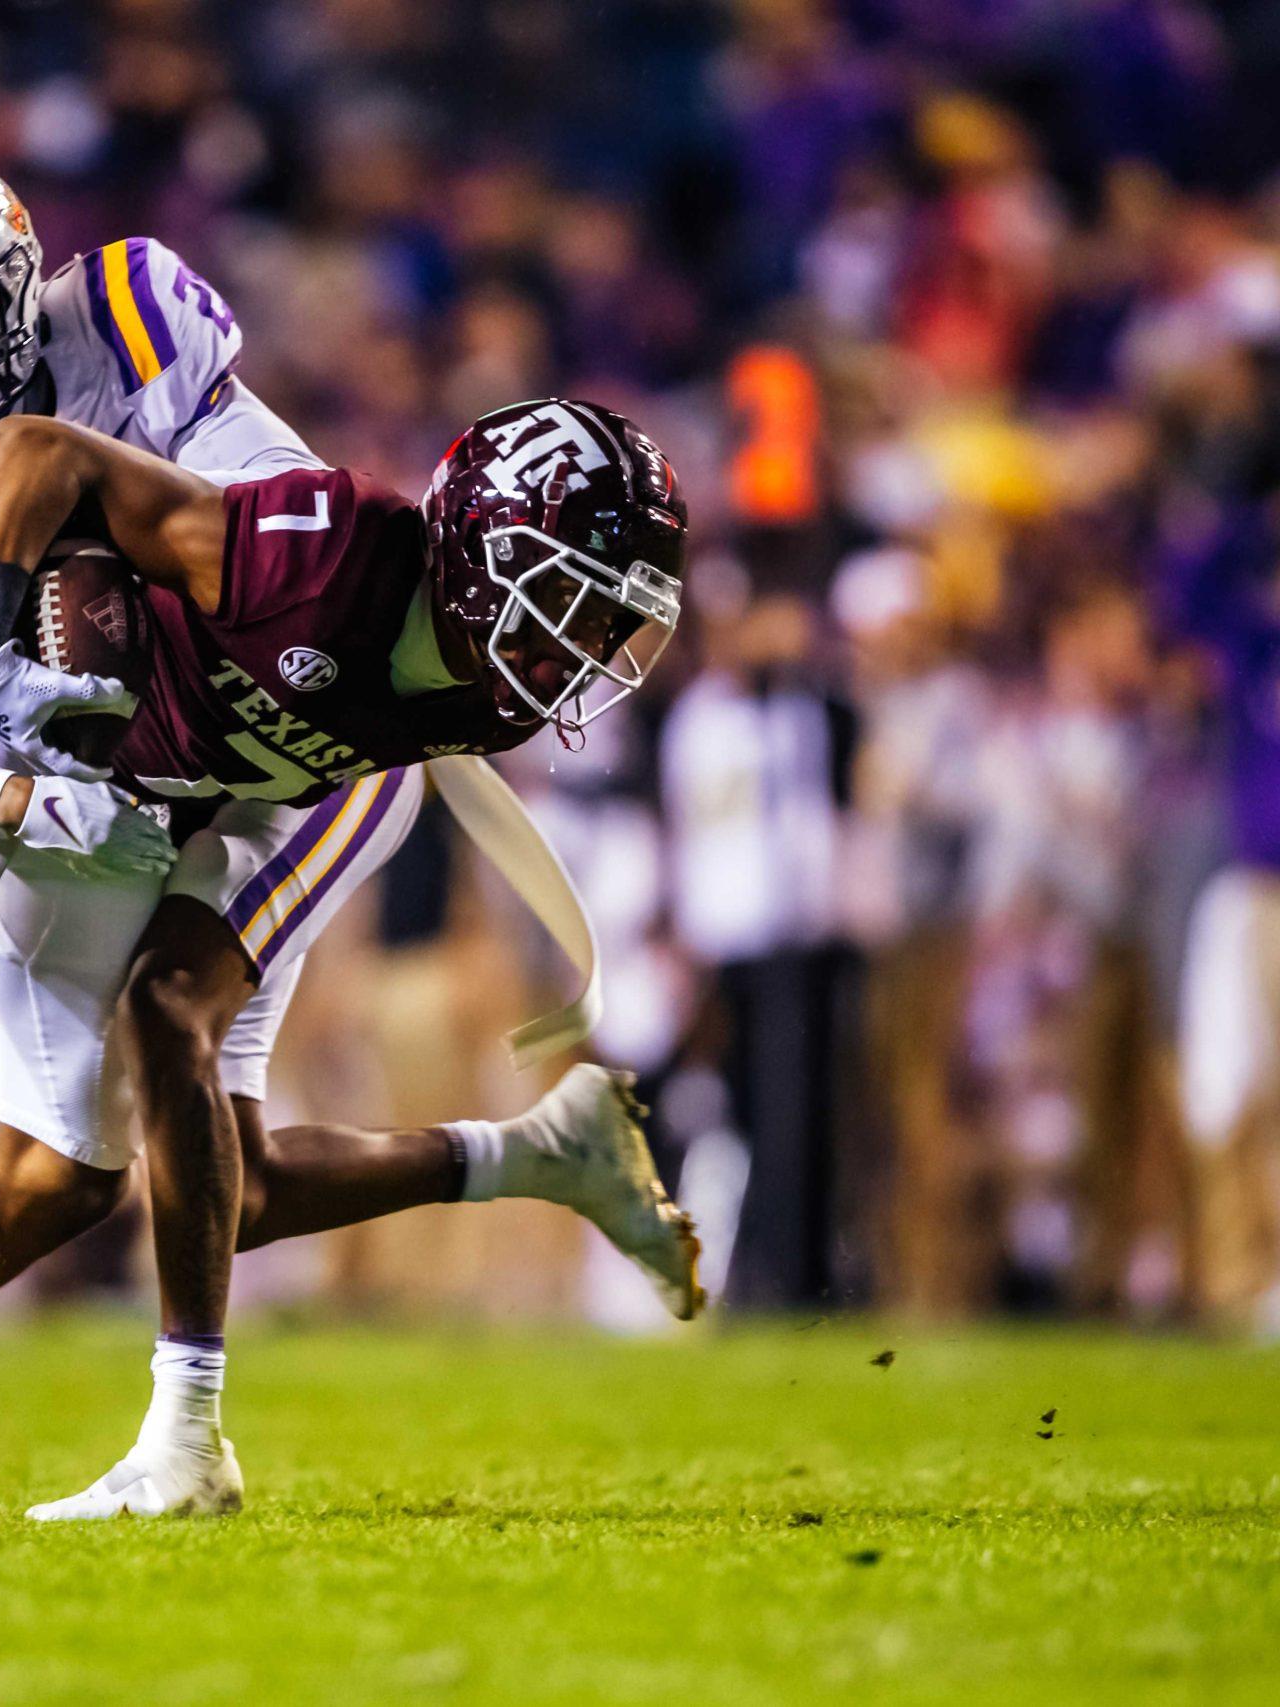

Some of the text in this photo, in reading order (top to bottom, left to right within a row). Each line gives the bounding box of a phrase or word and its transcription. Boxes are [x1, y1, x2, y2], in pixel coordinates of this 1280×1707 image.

[257, 491, 331, 533] 7
[283, 651, 333, 689] SEC
[208, 659, 354, 768] TEXAS
